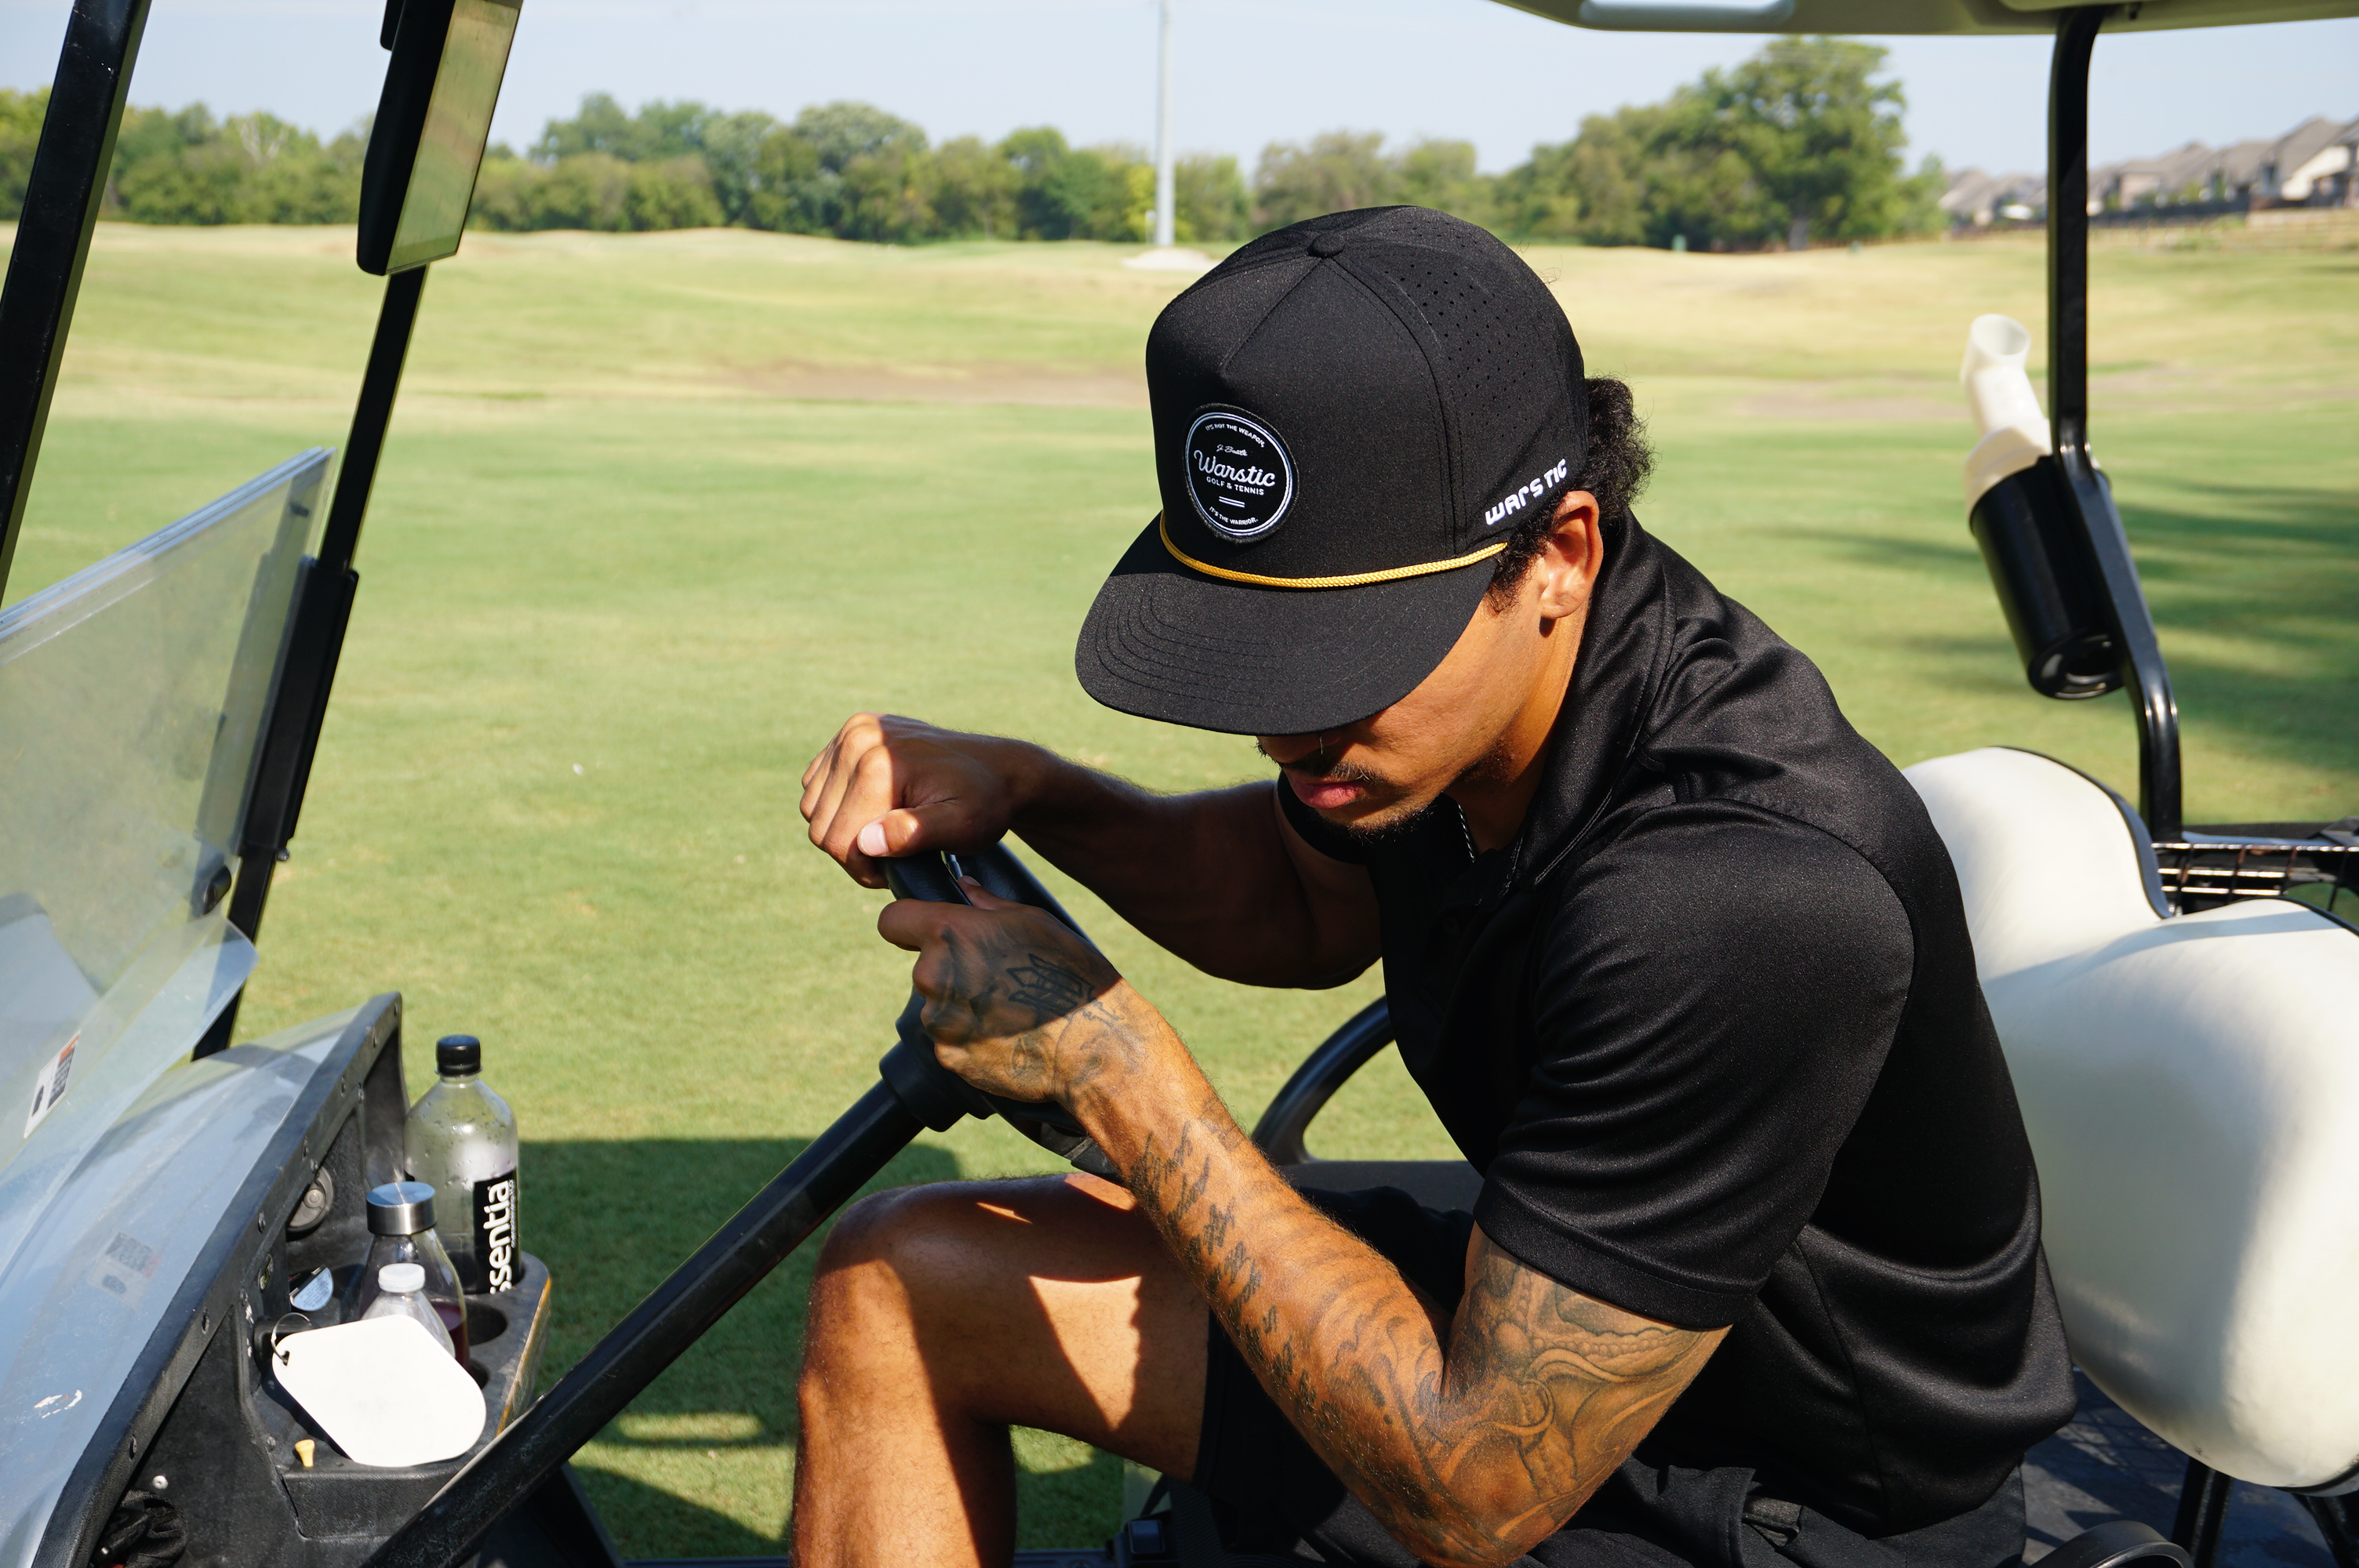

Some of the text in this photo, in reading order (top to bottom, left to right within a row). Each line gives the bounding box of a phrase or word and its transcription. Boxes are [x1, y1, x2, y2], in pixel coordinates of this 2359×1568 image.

[1226, 423, 1238, 432] THE
[1193, 449, 1276, 487] Warstic
[1206, 476, 1225, 487] GOLF
[1234, 484, 1265, 496] TENNIS
[1219, 514, 1230, 523] THE
